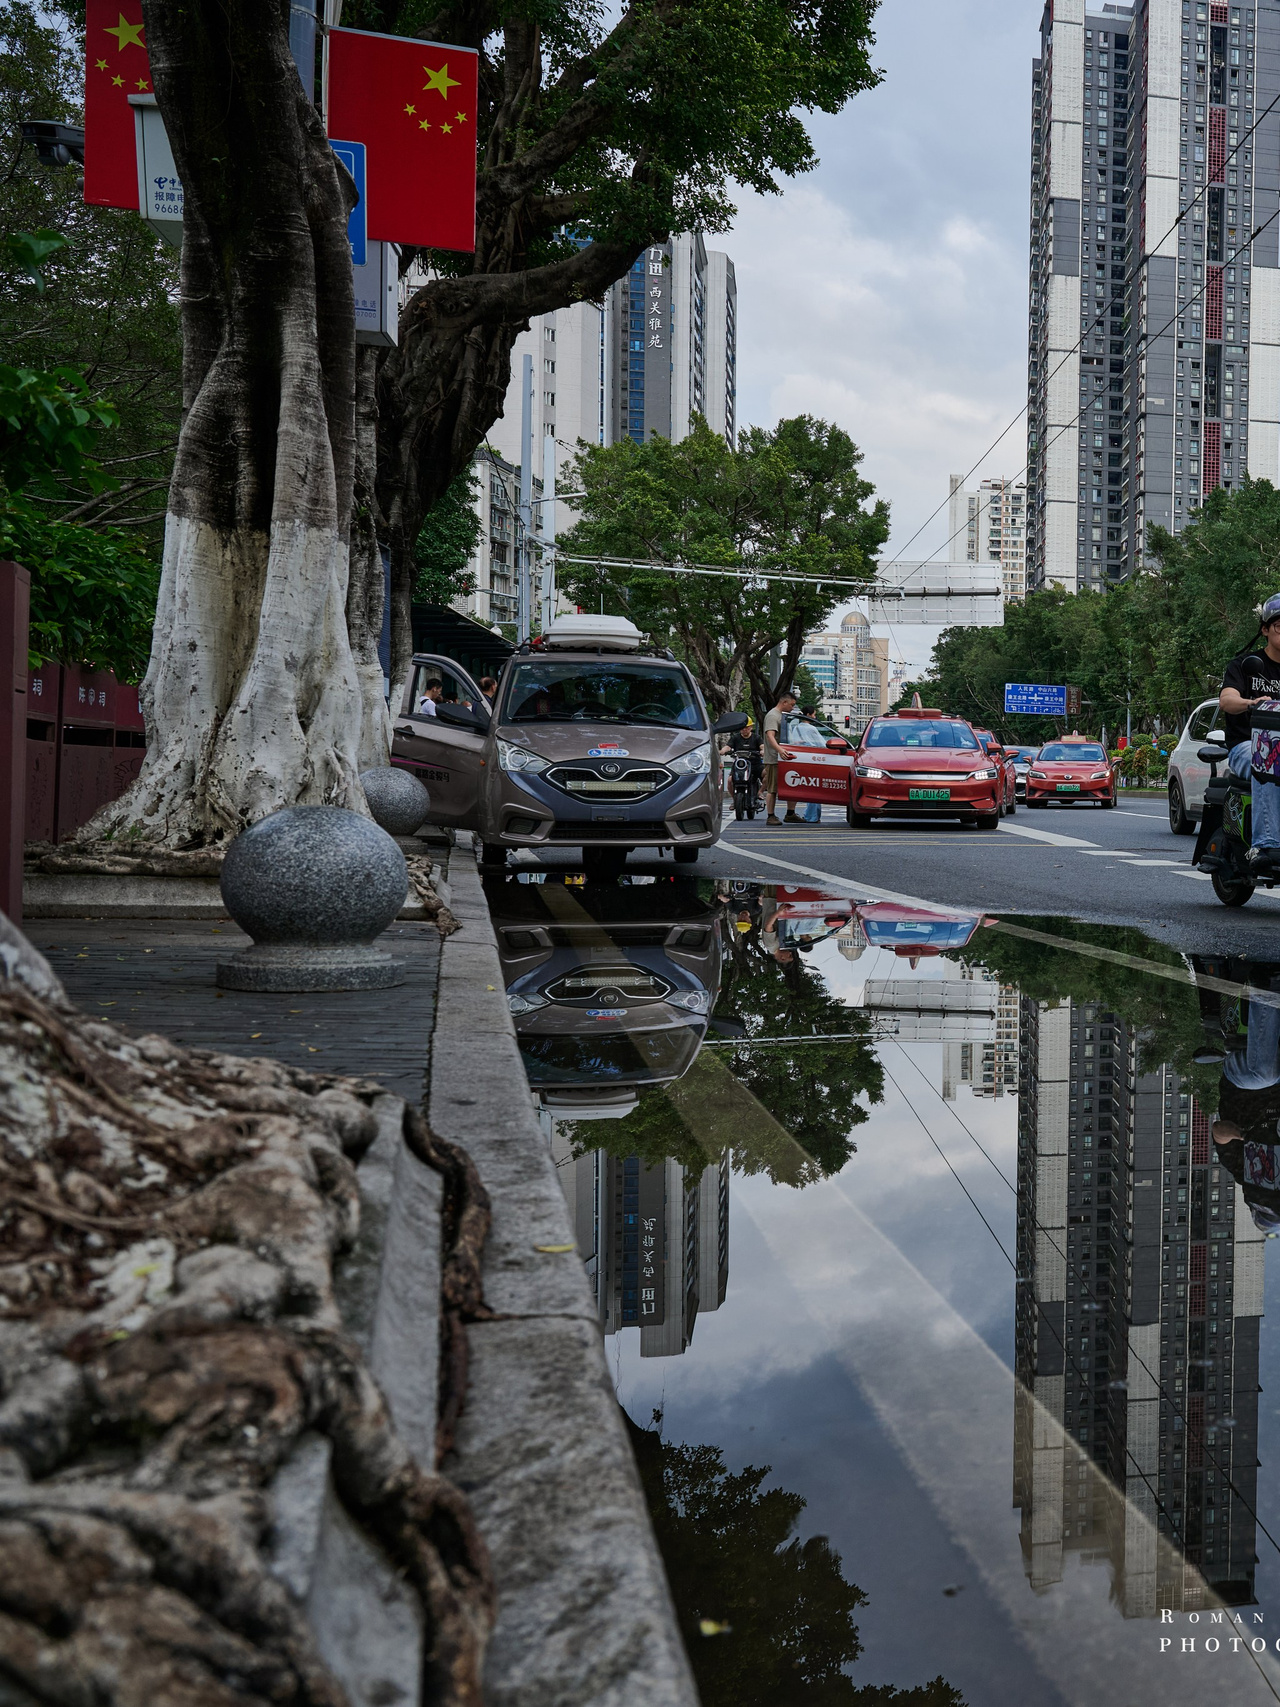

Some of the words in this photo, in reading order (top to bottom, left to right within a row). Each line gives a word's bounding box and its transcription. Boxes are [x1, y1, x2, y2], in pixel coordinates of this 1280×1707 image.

[648, 287, 663, 348] 西关雅苑
[1252, 677, 1265, 686] THE
[785, 770, 820, 787] TAXI
[829, 782, 847, 790] 12345
